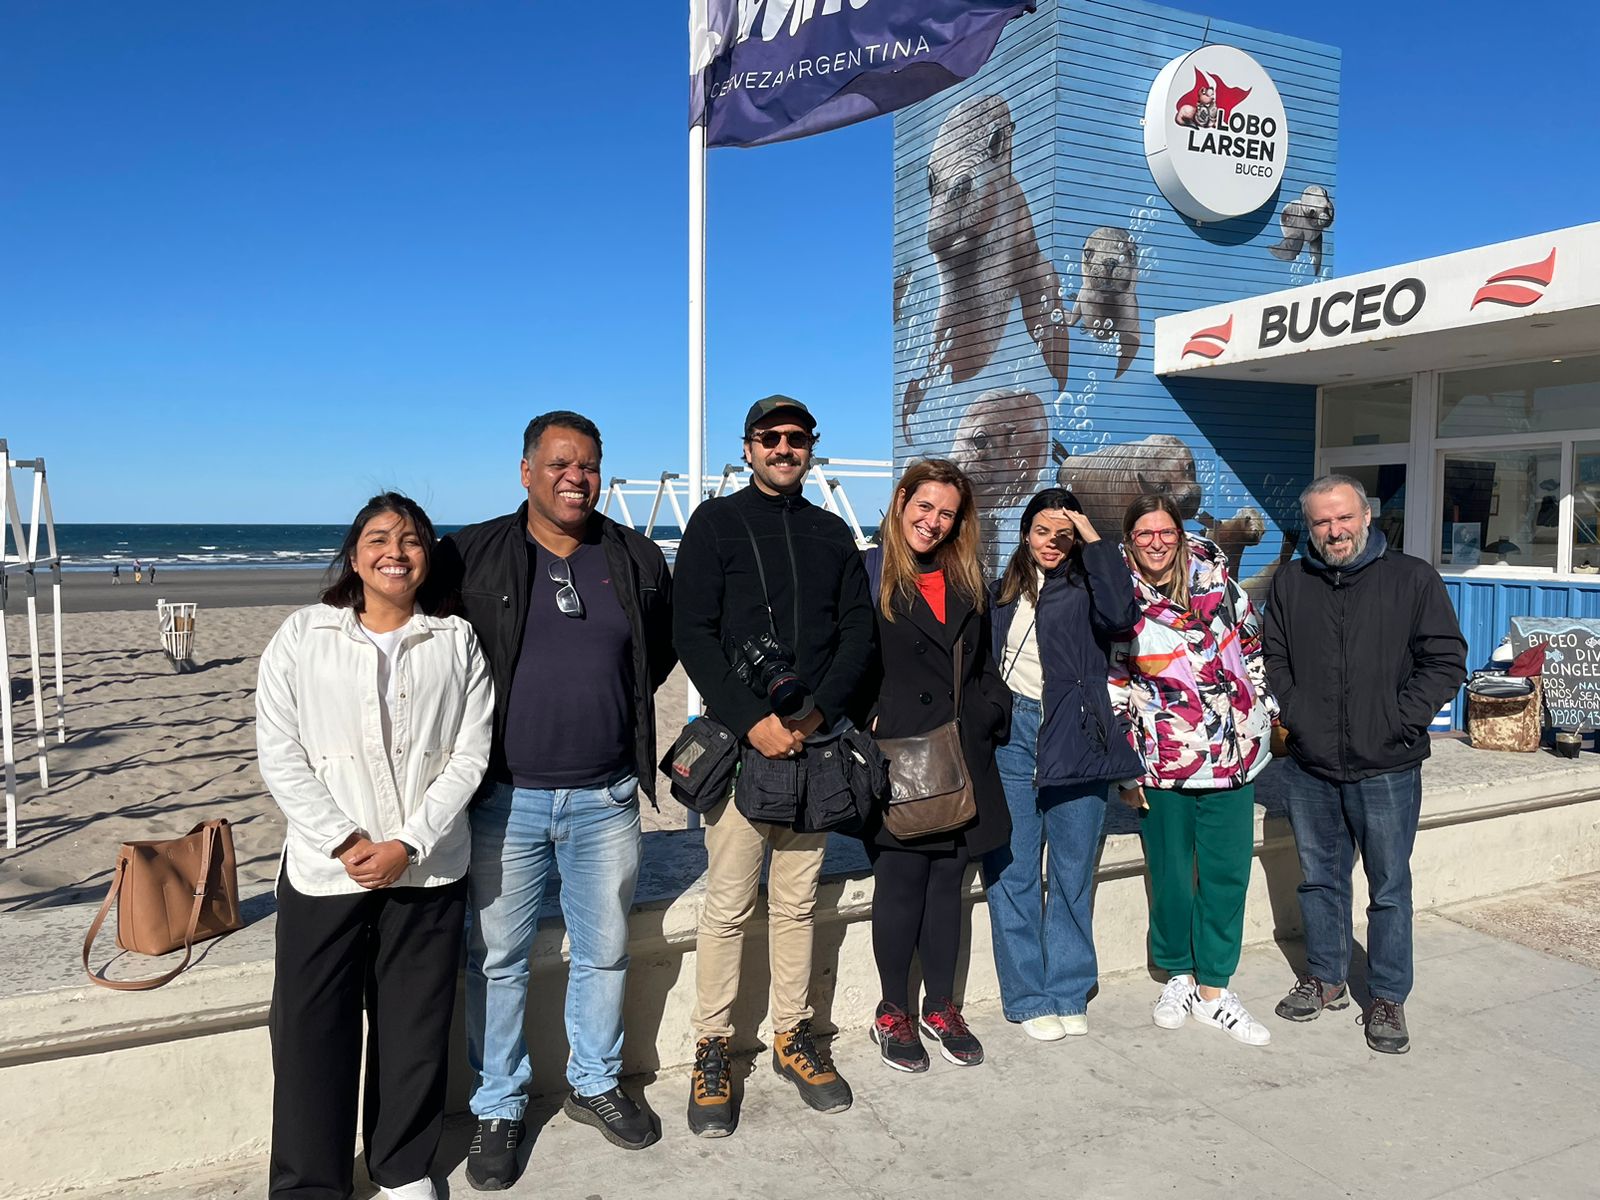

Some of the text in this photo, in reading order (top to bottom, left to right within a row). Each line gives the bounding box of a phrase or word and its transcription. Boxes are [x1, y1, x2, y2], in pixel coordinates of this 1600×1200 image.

[785, 36, 929, 83] ARGENTINA
[1216, 110, 1277, 138] LOBO
[1187, 130, 1275, 162] LARSEN
[1235, 163, 1273, 178] BUCEO
[1258, 277, 1427, 349] BUCEO
[1542, 677, 1566, 689] BOS
